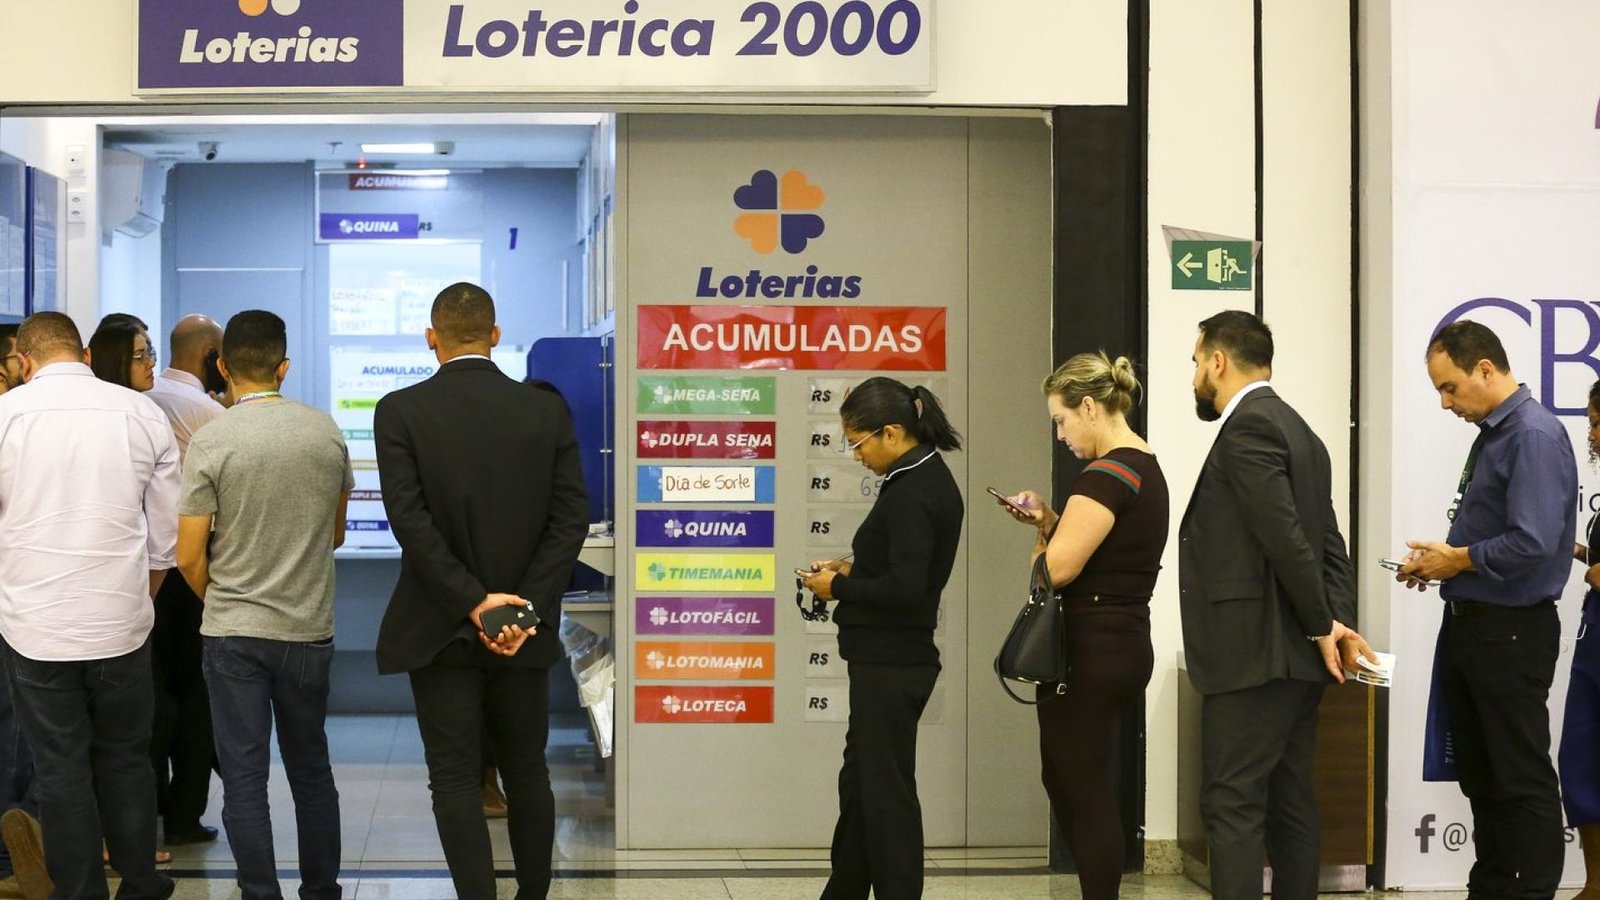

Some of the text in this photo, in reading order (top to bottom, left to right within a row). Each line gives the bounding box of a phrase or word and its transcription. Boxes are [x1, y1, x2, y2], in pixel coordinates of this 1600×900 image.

[442, 0, 921, 57] Loterica 2000
[179, 25, 359, 63] Loterias
[354, 220, 399, 233] QUINA
[509, 227, 518, 250] 1
[696, 264, 862, 299] Loterias
[662, 323, 922, 353] ACUMULADAS
[673, 388, 760, 402] MEGA-SENA
[811, 389, 831, 403] R$
[659, 433, 772, 447] DUPLA SENA
[811, 433, 830, 447] R$
[665, 475, 751, 491] Dia de Sorte
[811, 477, 830, 491] R$
[685, 521, 747, 537] QUINA
[811, 521, 830, 535] R$
[669, 567, 763, 580] TIMEMANIA
[670, 607, 761, 624] LOTOFÁCIL
[666, 655, 763, 669] LOTOMANIA
[809, 652, 828, 666] R$
[682, 699, 746, 712] LOTECA
[809, 696, 828, 710] R$
